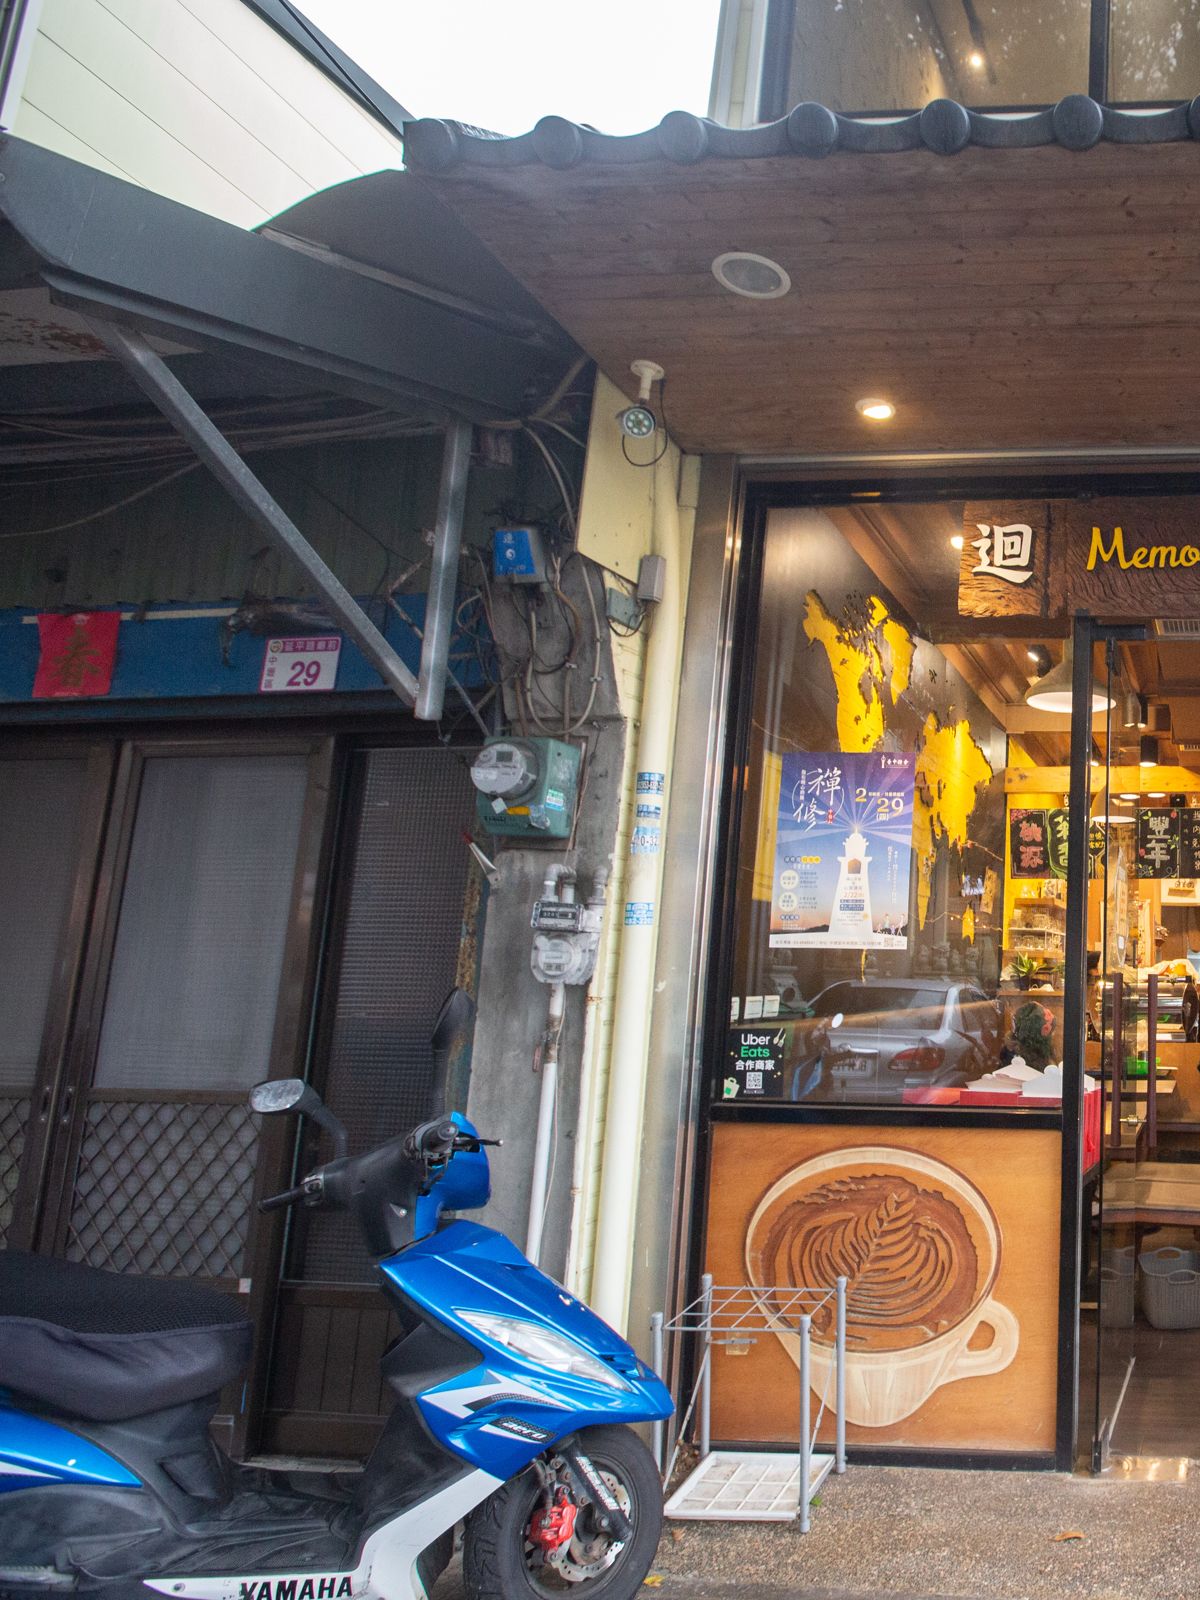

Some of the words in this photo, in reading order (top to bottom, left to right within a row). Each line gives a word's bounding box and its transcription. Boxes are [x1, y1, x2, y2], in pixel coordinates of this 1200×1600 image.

[971, 523, 1033, 584] 迴
[286, 660, 321, 687] 29
[741, 1034, 771, 1045] Uber
[740, 1046, 770, 1057] Eats
[735, 1060, 775, 1071] 合作商家
[241, 1576, 353, 1600] YAMAHA
